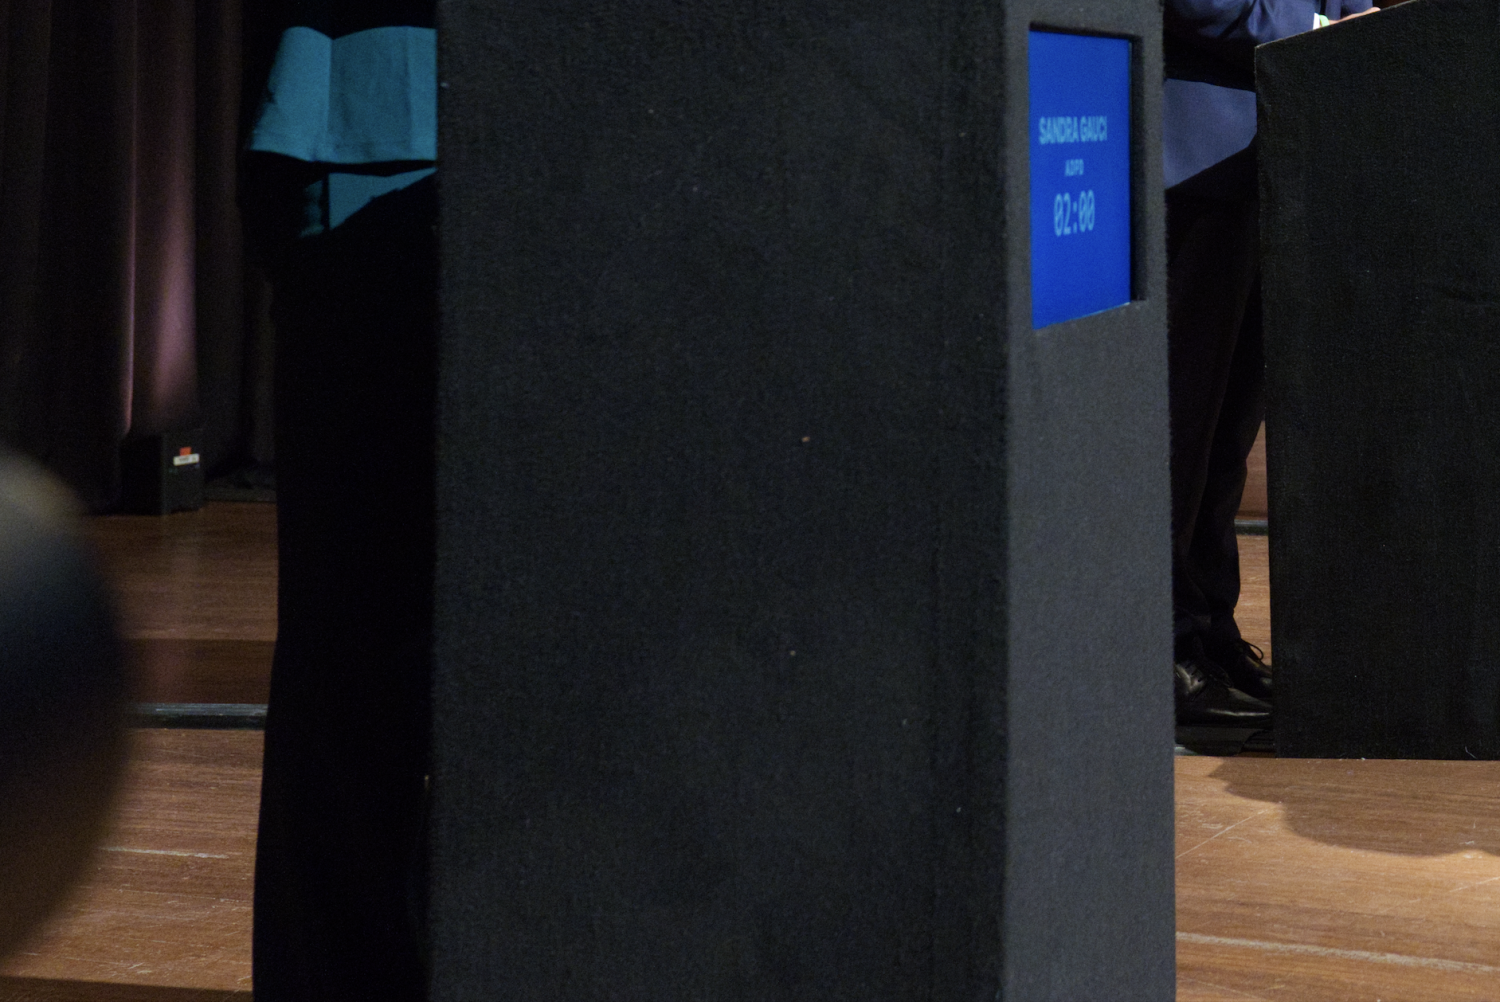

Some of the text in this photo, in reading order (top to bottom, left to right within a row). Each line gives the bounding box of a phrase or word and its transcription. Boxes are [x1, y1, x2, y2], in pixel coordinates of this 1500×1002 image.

[1038, 115, 1107, 145] SANDRA GAUCI
[1065, 159, 1084, 176] ADPD
[1054, 190, 1095, 237] 02:00
